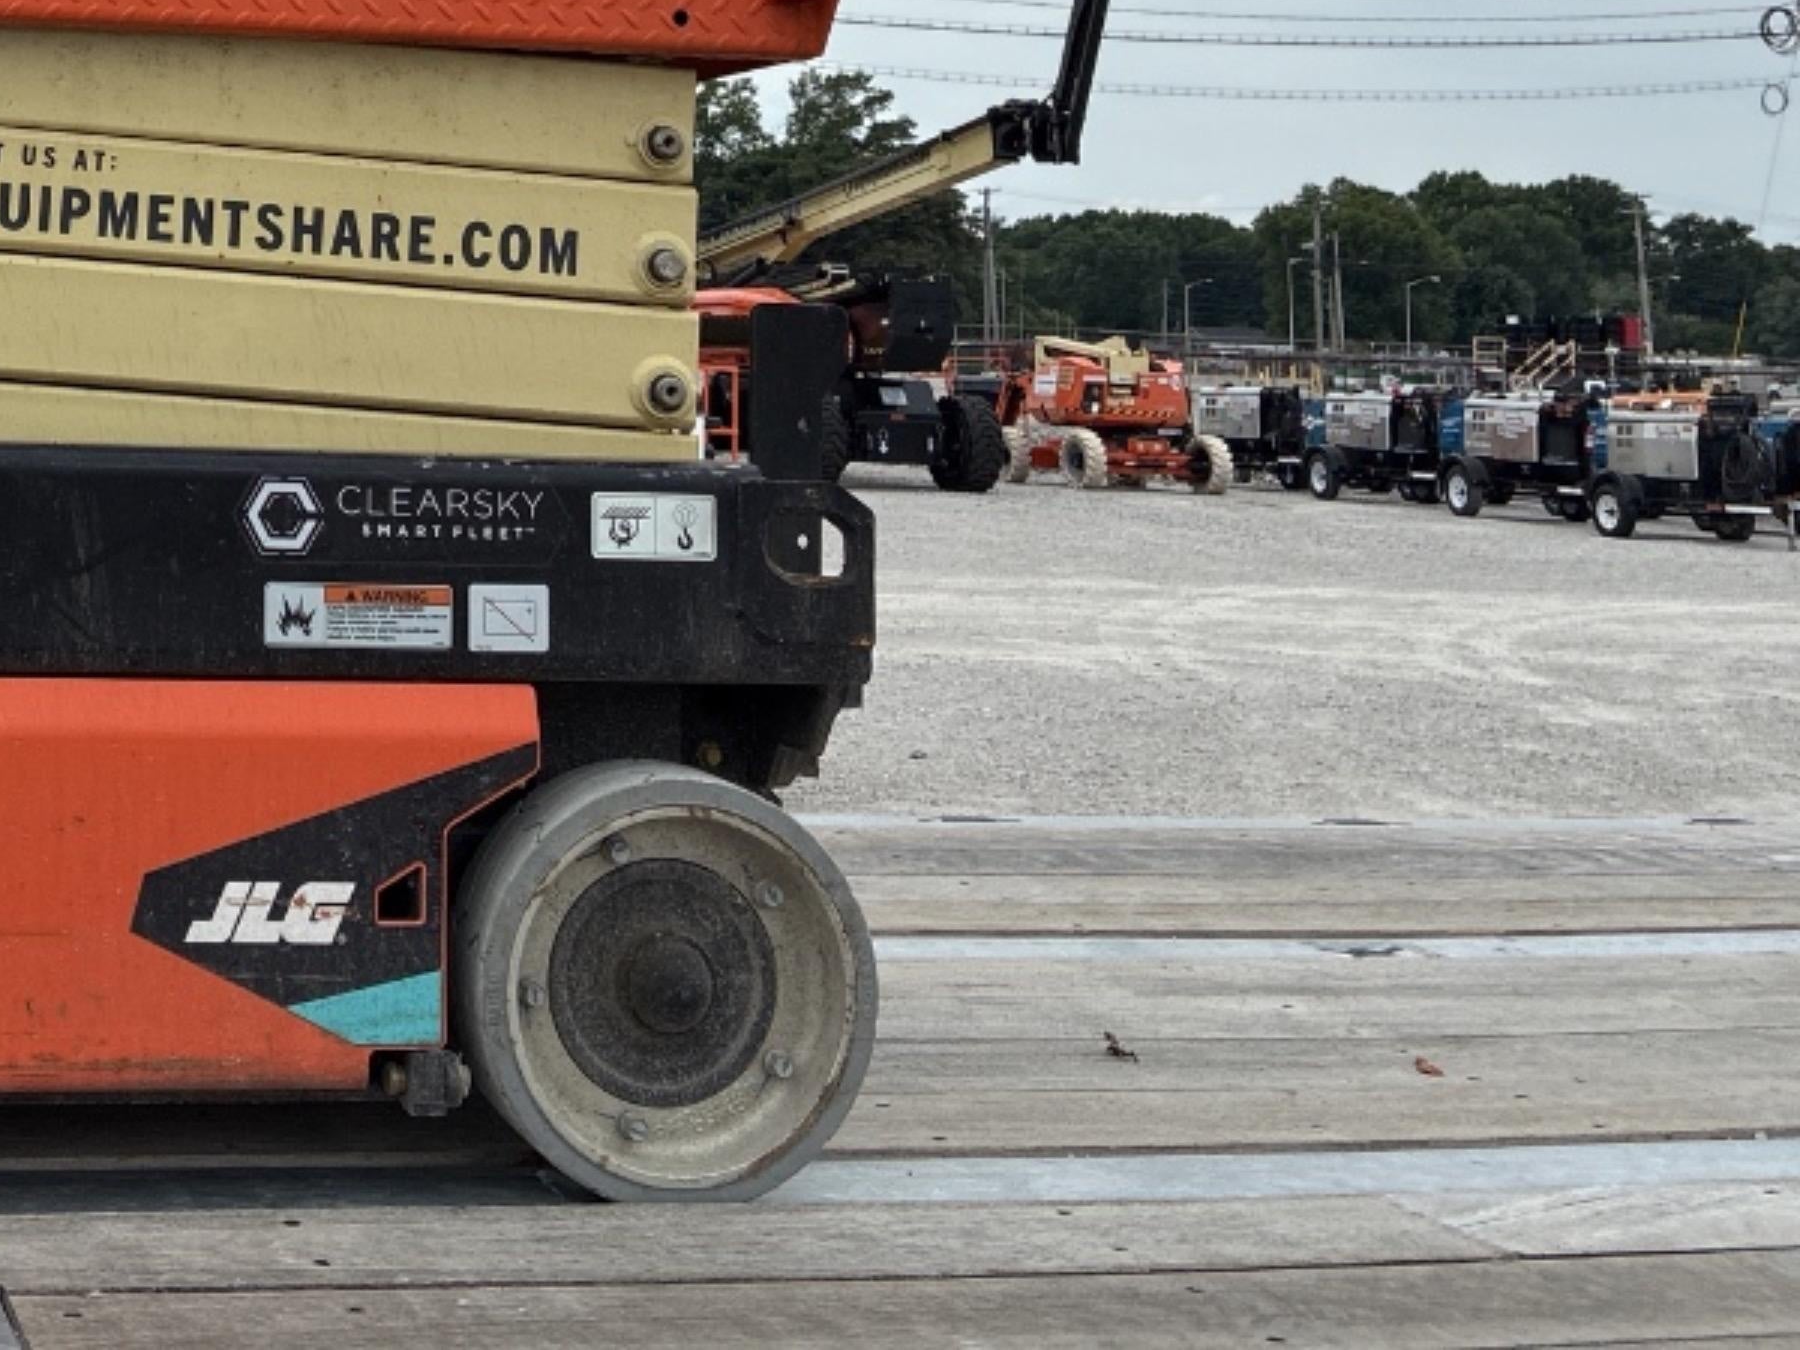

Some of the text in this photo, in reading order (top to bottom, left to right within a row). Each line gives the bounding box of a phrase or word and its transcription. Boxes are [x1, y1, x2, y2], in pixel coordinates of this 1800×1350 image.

[21, 144, 57, 168] US
[73, 149, 119, 172] AT:
[336, 485, 544, 520] CLEARSKY
[361, 522, 442, 539] SMART
[362, 590, 429, 603] WARNING
[184, 881, 356, 945] JLG
